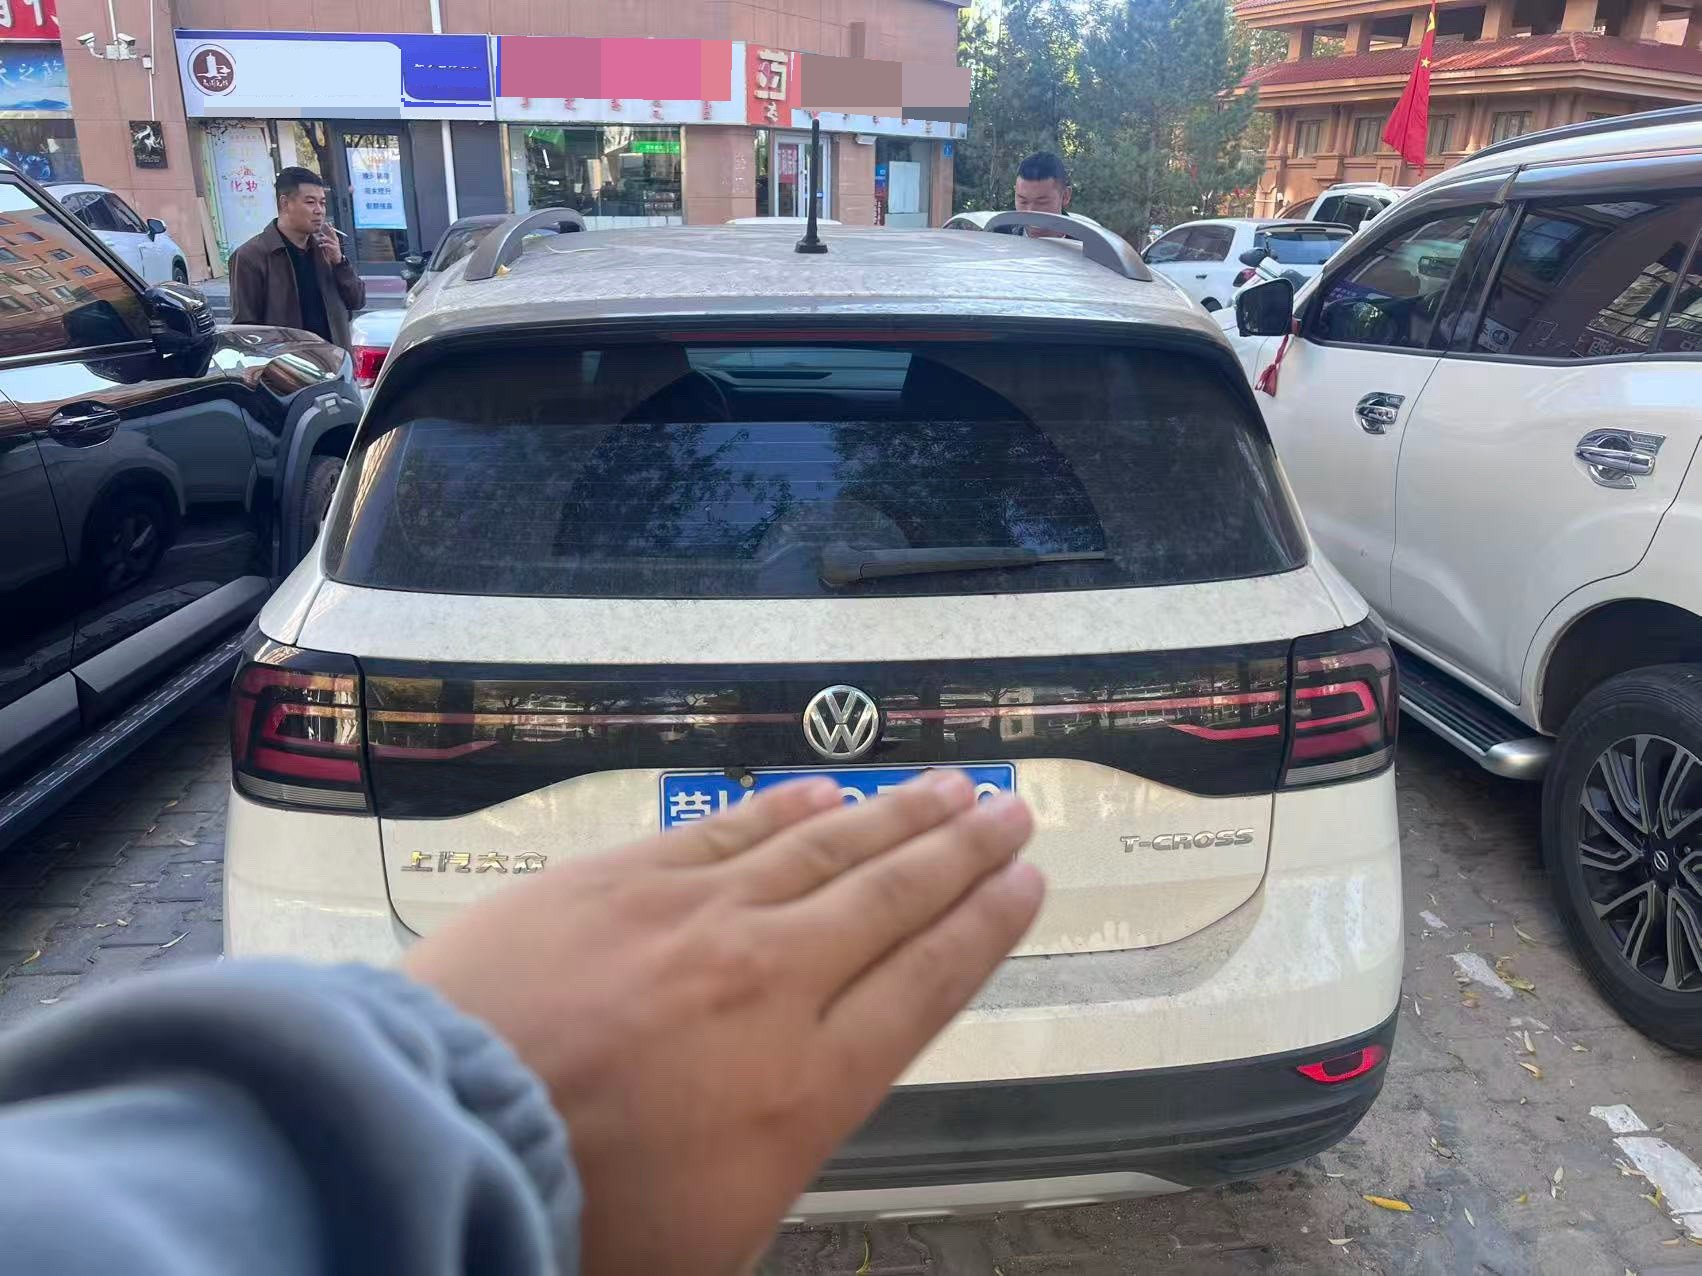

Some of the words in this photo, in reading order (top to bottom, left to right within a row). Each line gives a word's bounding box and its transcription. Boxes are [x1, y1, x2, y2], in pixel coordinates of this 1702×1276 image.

[1120, 828, 1255, 853] T-CROSS
[400, 850, 548, 874] 上汽大众
